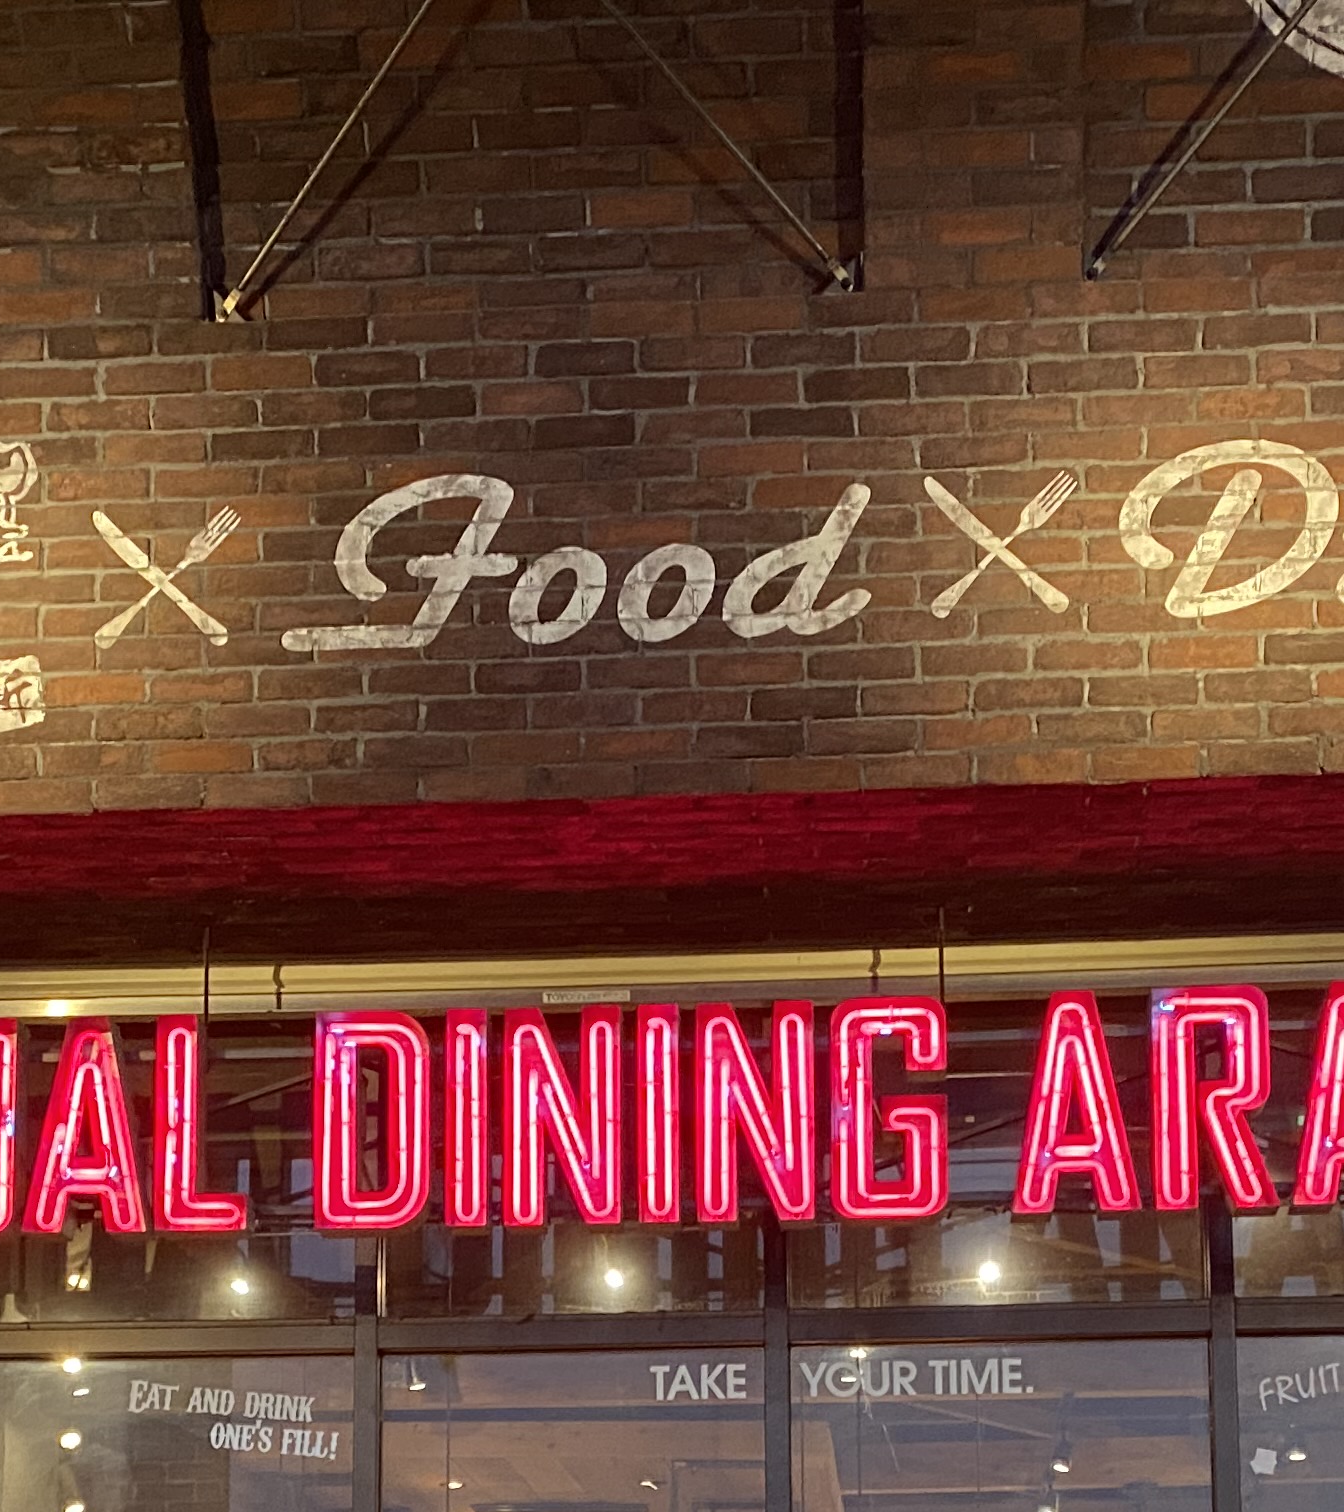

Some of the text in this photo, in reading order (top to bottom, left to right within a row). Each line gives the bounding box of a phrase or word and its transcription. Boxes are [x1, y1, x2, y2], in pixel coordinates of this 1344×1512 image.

[281, 474, 872, 652] Food
[314, 995, 948, 1228] DINING
[649, 1358, 1035, 1400] TAKE YOUR TIME.
[1258, 1363, 1341, 1411] FRUIT
[187, 1386, 235, 1416] AND
[243, 1391, 316, 1422] DRINK
[210, 1418, 339, 1460] ONE'S FILL!
